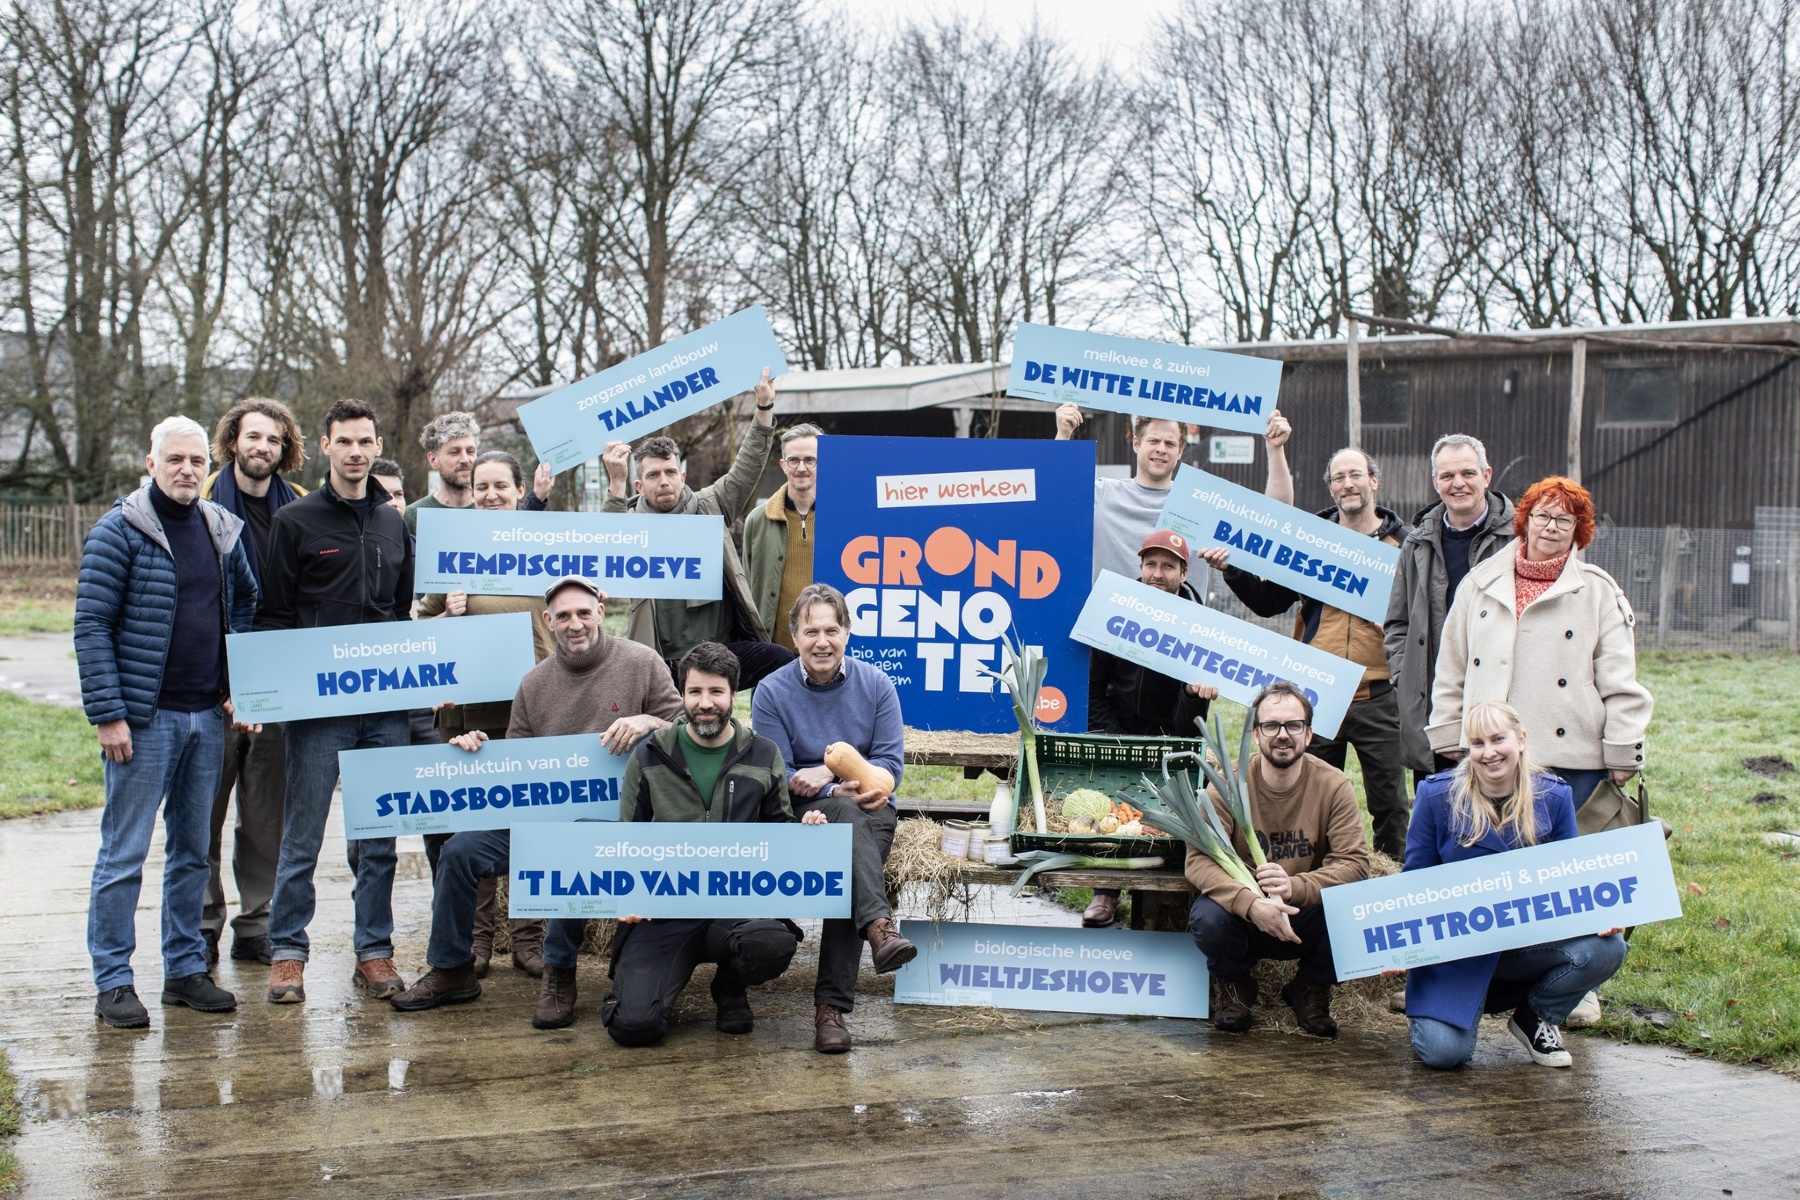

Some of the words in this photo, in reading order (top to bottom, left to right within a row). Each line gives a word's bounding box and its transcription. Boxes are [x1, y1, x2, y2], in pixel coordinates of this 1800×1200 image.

[576, 373, 647, 411] zorgzame
[648, 341, 719, 380] landbouw
[1084, 349, 1149, 370] melkvee
[1152, 357, 1163, 370] &
[1166, 360, 1211, 378] zuivel
[597, 366, 720, 432] TALANDER
[1024, 360, 1057, 385] DE
[1062, 366, 1135, 396] WITTE
[1138, 378, 1262, 416] LIEREMAN
[885, 481, 928, 502] hier
[937, 477, 1027, 499] werken
[1191, 488, 1279, 531] zelfpluktuin
[1281, 521, 1292, 536] &
[491, 525, 650, 549] zelfoogstboerderij
[437, 551, 599, 578] KEMPISCHE
[605, 555, 701, 580] HOEVE
[840, 526, 1061, 600] GROND
[1213, 519, 1273, 559] BARI
[1273, 544, 1370, 597] BESSEN
[845, 587, 1012, 640] GENO
[333, 636, 438, 660] bioboerderij
[851, 645, 874, 659] bio
[879, 648, 907, 658] van
[1109, 592, 1179, 625] zelfoogst
[1190, 622, 1268, 661] pakketten
[1281, 655, 1336, 686] horeca
[317, 661, 458, 697] HOFMARK
[1106, 615, 1319, 708] GROENTEGEWD
[415, 757, 523, 779] zelfpluktuin
[526, 757, 561, 770] van
[565, 752, 590, 768] de
[376, 777, 622, 817] STADSBOERDERI
[594, 841, 769, 862] zelfoogstboerderij
[551, 870, 636, 896] LAND
[639, 870, 700, 896] VAN
[707, 870, 844, 896] RHOODE
[1352, 872, 1514, 922] groenteboerderij
[1518, 868, 1533, 885] &
[1537, 848, 1639, 889] pakketten
[1363, 918, 1423, 953] HET
[1426, 876, 1638, 941] TROETELHOF
[974, 939, 1074, 960] biologische
[1079, 944, 1133, 961] hoeve
[939, 963, 1166, 997] WIELTJESHOEVE
